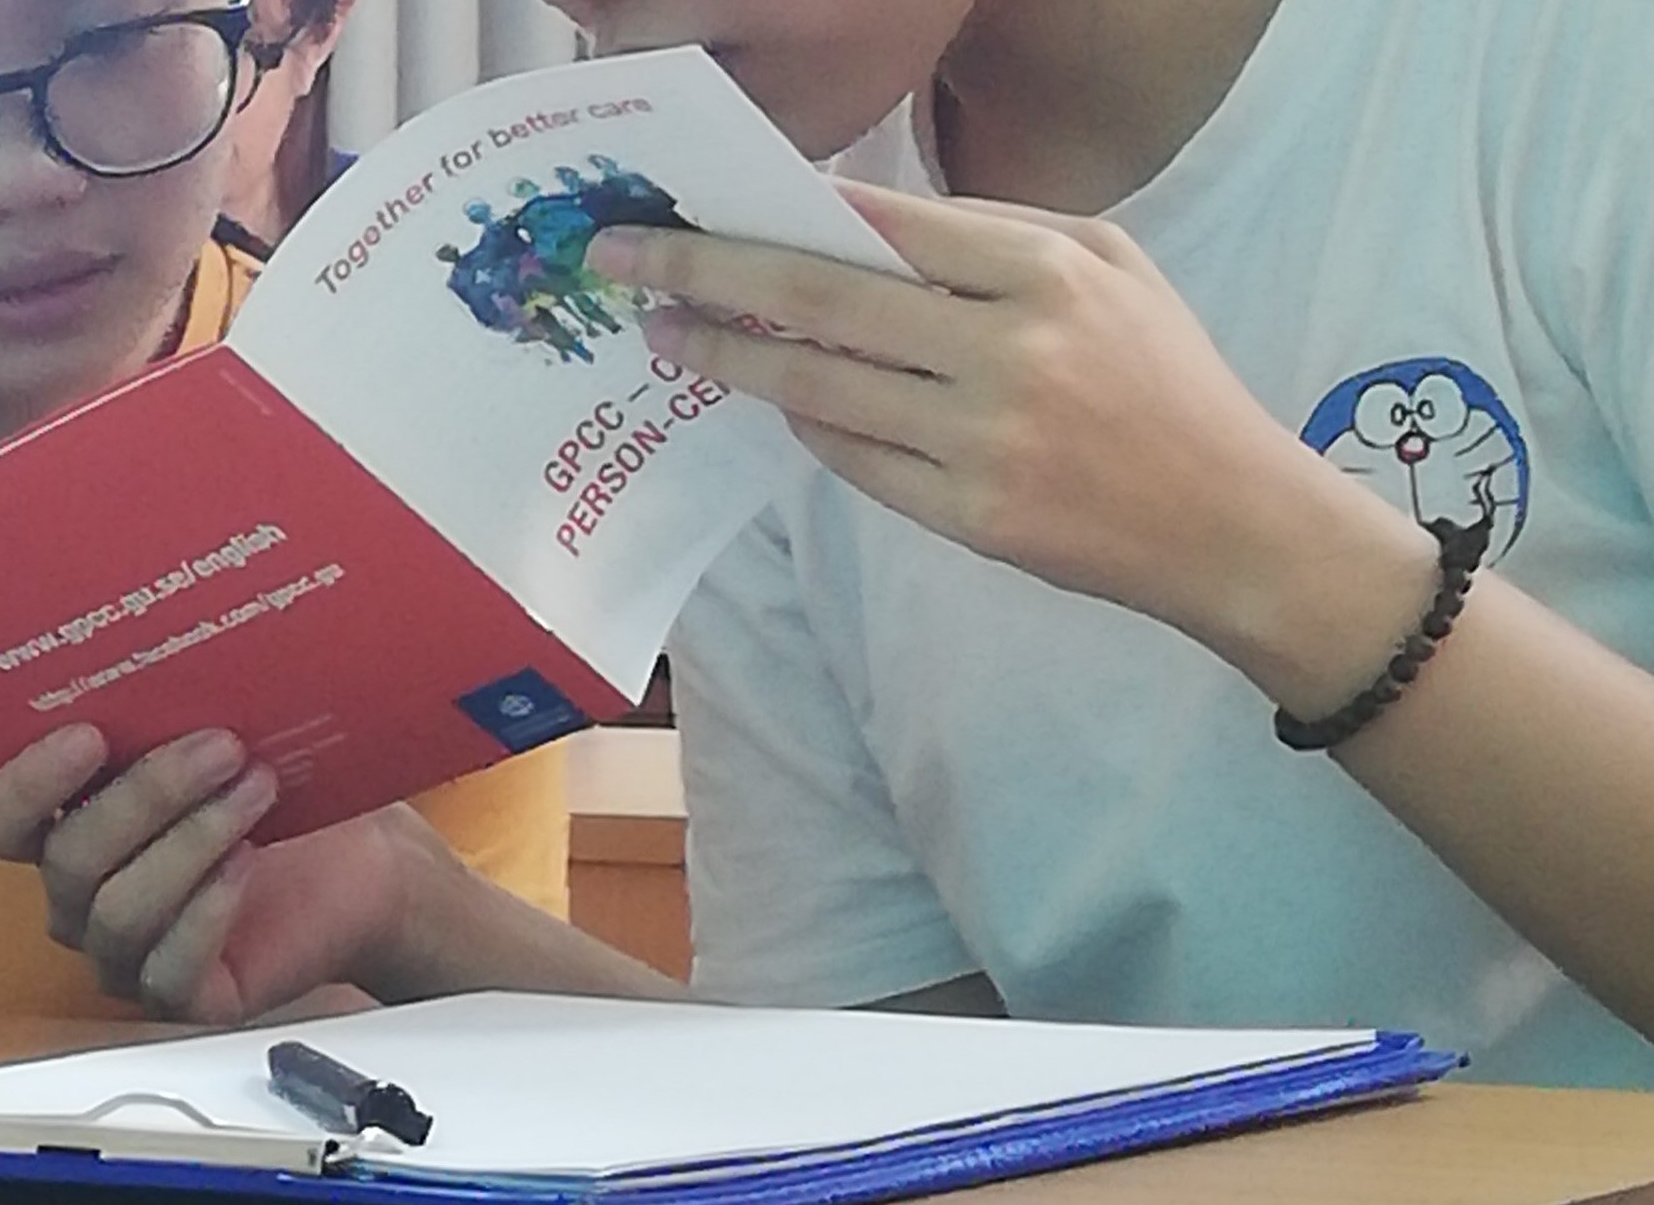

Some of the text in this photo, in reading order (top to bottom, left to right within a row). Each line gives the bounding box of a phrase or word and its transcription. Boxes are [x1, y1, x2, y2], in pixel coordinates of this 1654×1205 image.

[314, 97, 653, 295] Together for better care
[544, 401, 624, 493] GPCC
[556, 376, 731, 557] PERSON-CE
